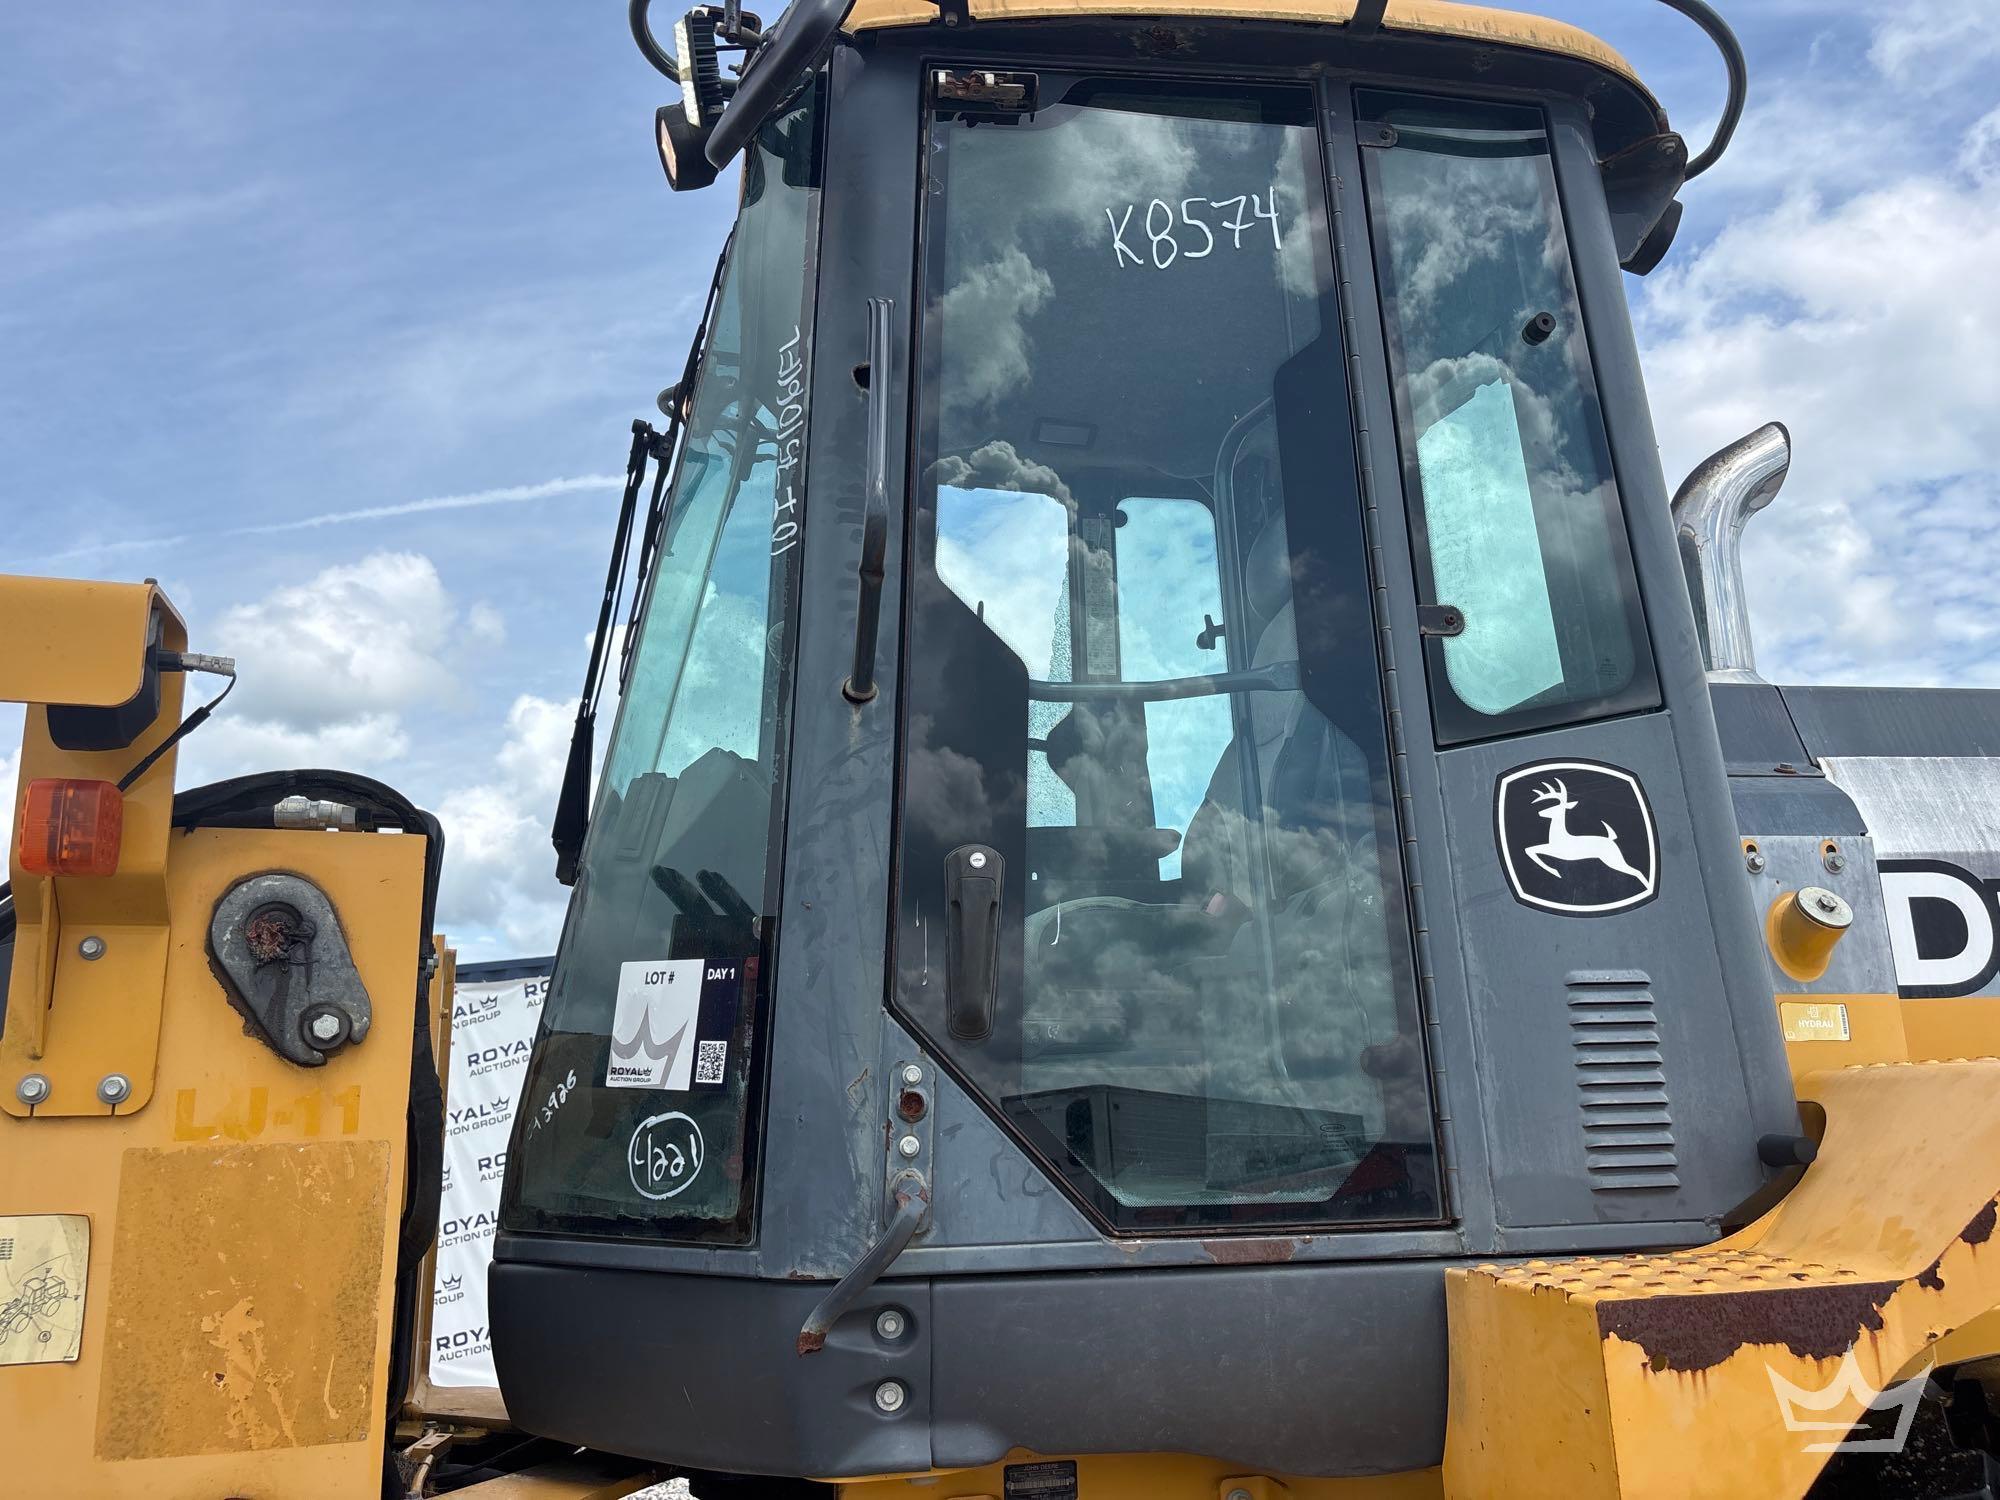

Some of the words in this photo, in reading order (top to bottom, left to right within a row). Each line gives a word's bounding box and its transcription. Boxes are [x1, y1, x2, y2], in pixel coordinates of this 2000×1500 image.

[1105, 186, 1282, 269] K8574
[1879, 872, 2000, 986] D
[645, 971, 666, 985] LOT
[707, 968, 728, 980] DAY
[730, 967, 735, 979] 1
[461, 1010, 501, 1028] GROUP
[469, 1057, 520, 1077] AUCTION
[610, 1067, 643, 1076] ROYAL
[471, 1113, 512, 1130] GROUP
[634, 1132, 699, 1187] 4221
[438, 1344, 491, 1363] AUCTION
